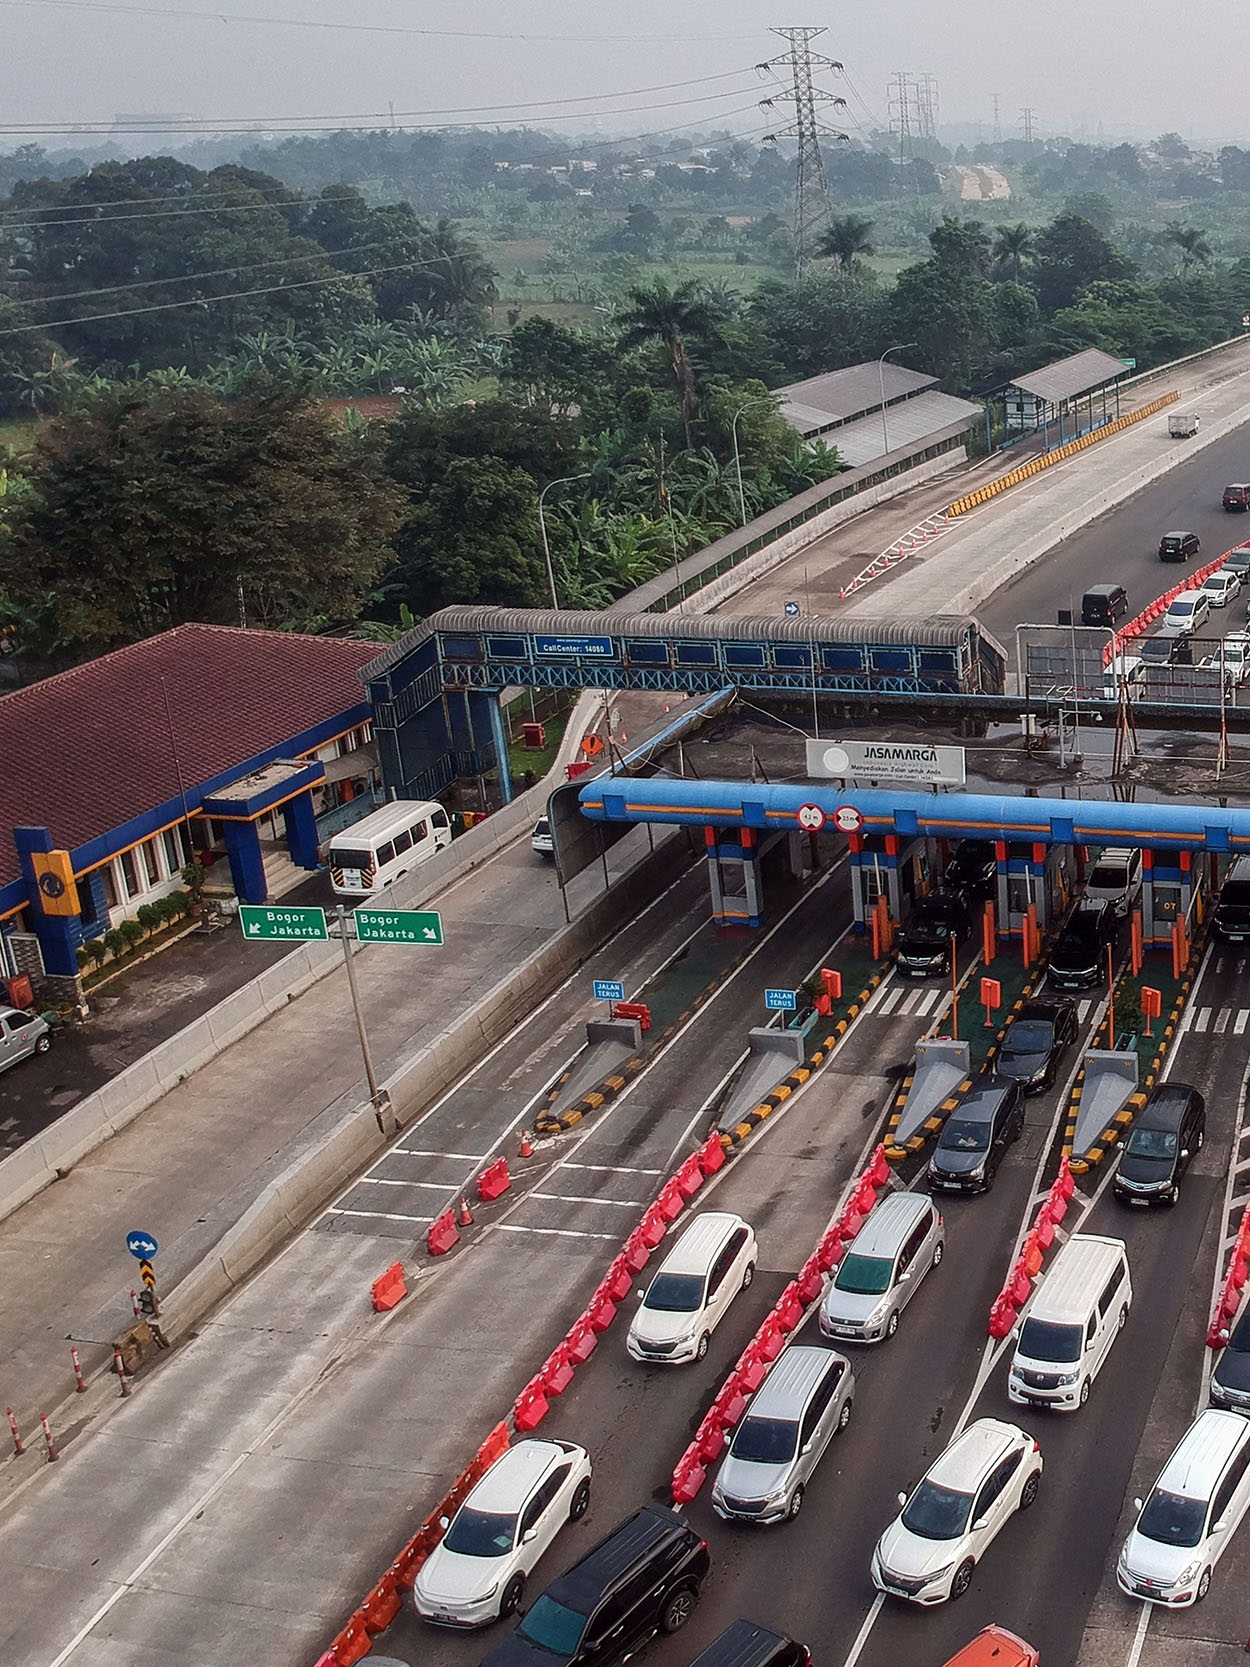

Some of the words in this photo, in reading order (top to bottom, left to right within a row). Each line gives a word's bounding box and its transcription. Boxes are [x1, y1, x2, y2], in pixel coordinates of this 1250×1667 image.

[864, 747, 937, 762] JASAMARGA
[1163, 902, 1176, 911] 07
[266, 911, 305, 924] Bogor
[360, 915, 399, 927] Bogor
[270, 926, 321, 937] Jakarta
[364, 929, 415, 939] Jakarta
[596, 983, 620, 991] JALAN
[597, 990, 620, 998] TERUS
[769, 999, 793, 1007] TERUS
